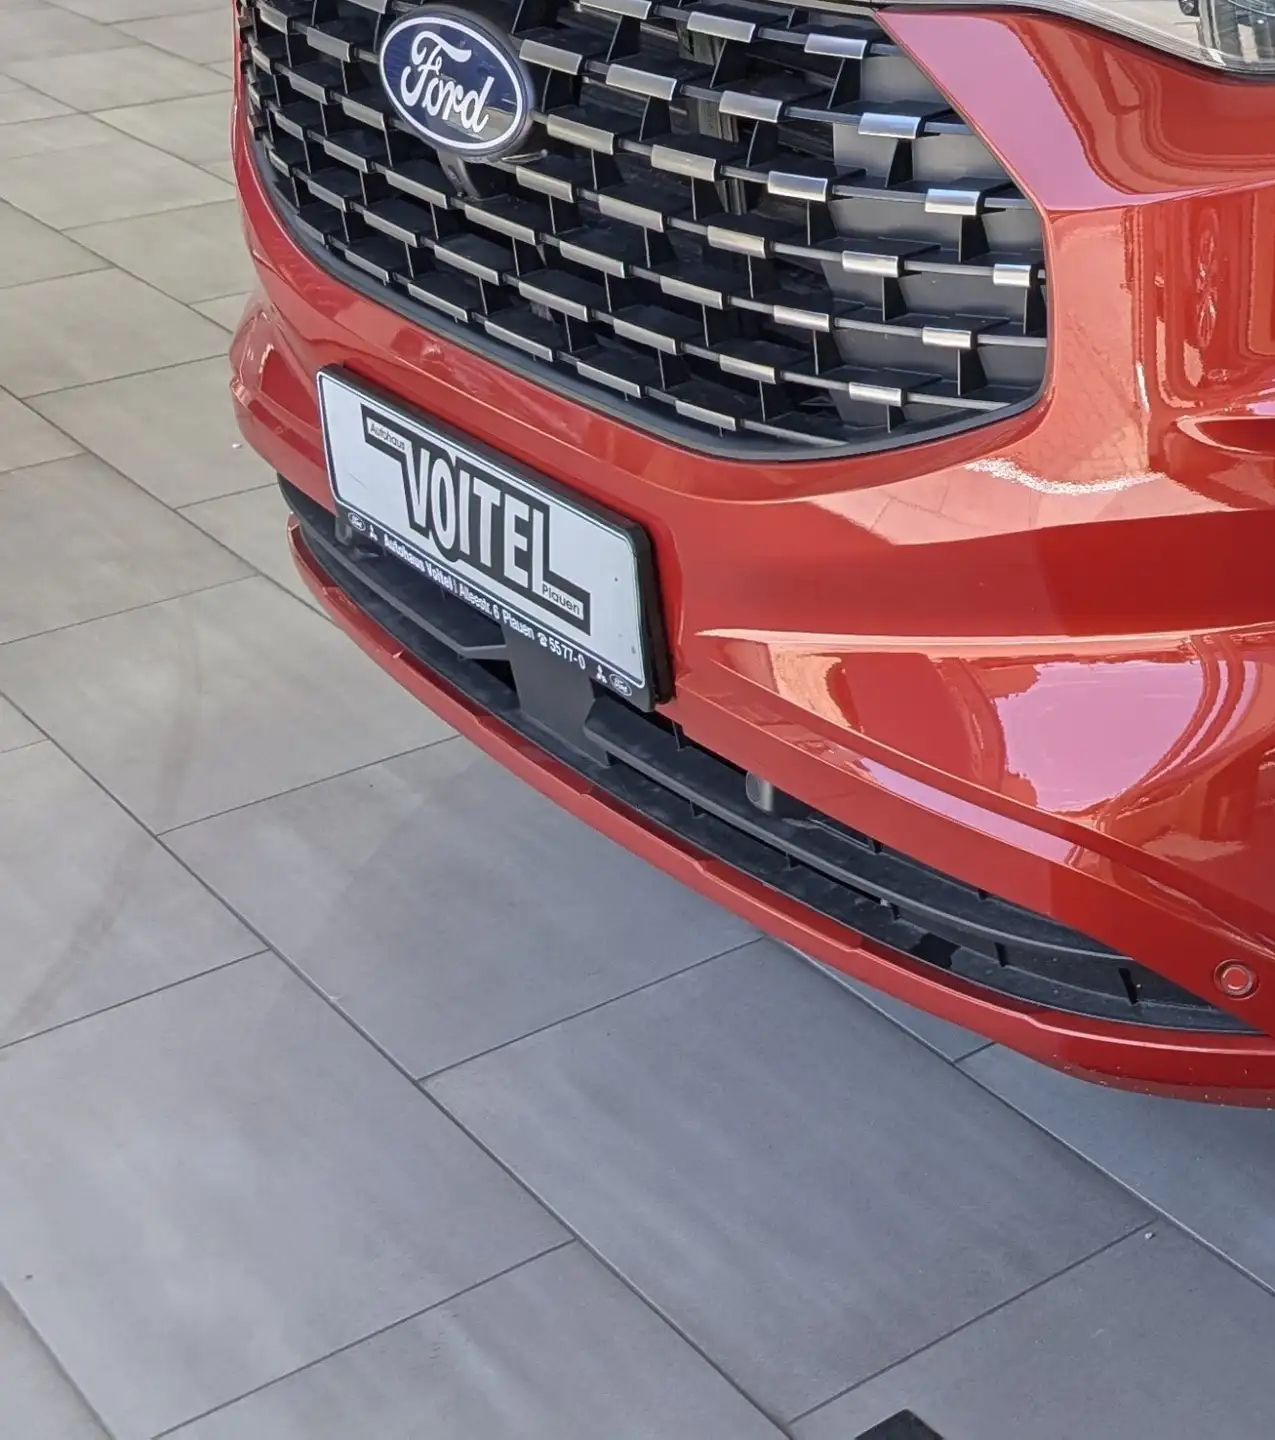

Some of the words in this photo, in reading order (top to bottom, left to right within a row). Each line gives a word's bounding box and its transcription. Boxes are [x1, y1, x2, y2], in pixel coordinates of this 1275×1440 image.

[400, 30, 496, 133] Ford
[370, 422, 406, 450] Autohaus
[404, 445, 545, 593] VOITEL
[383, 533, 426, 573] Autohaus
[424, 560, 453, 591] Voitel
[502, 610, 535, 641] Plauen
[541, 584, 581, 616] Plauen
